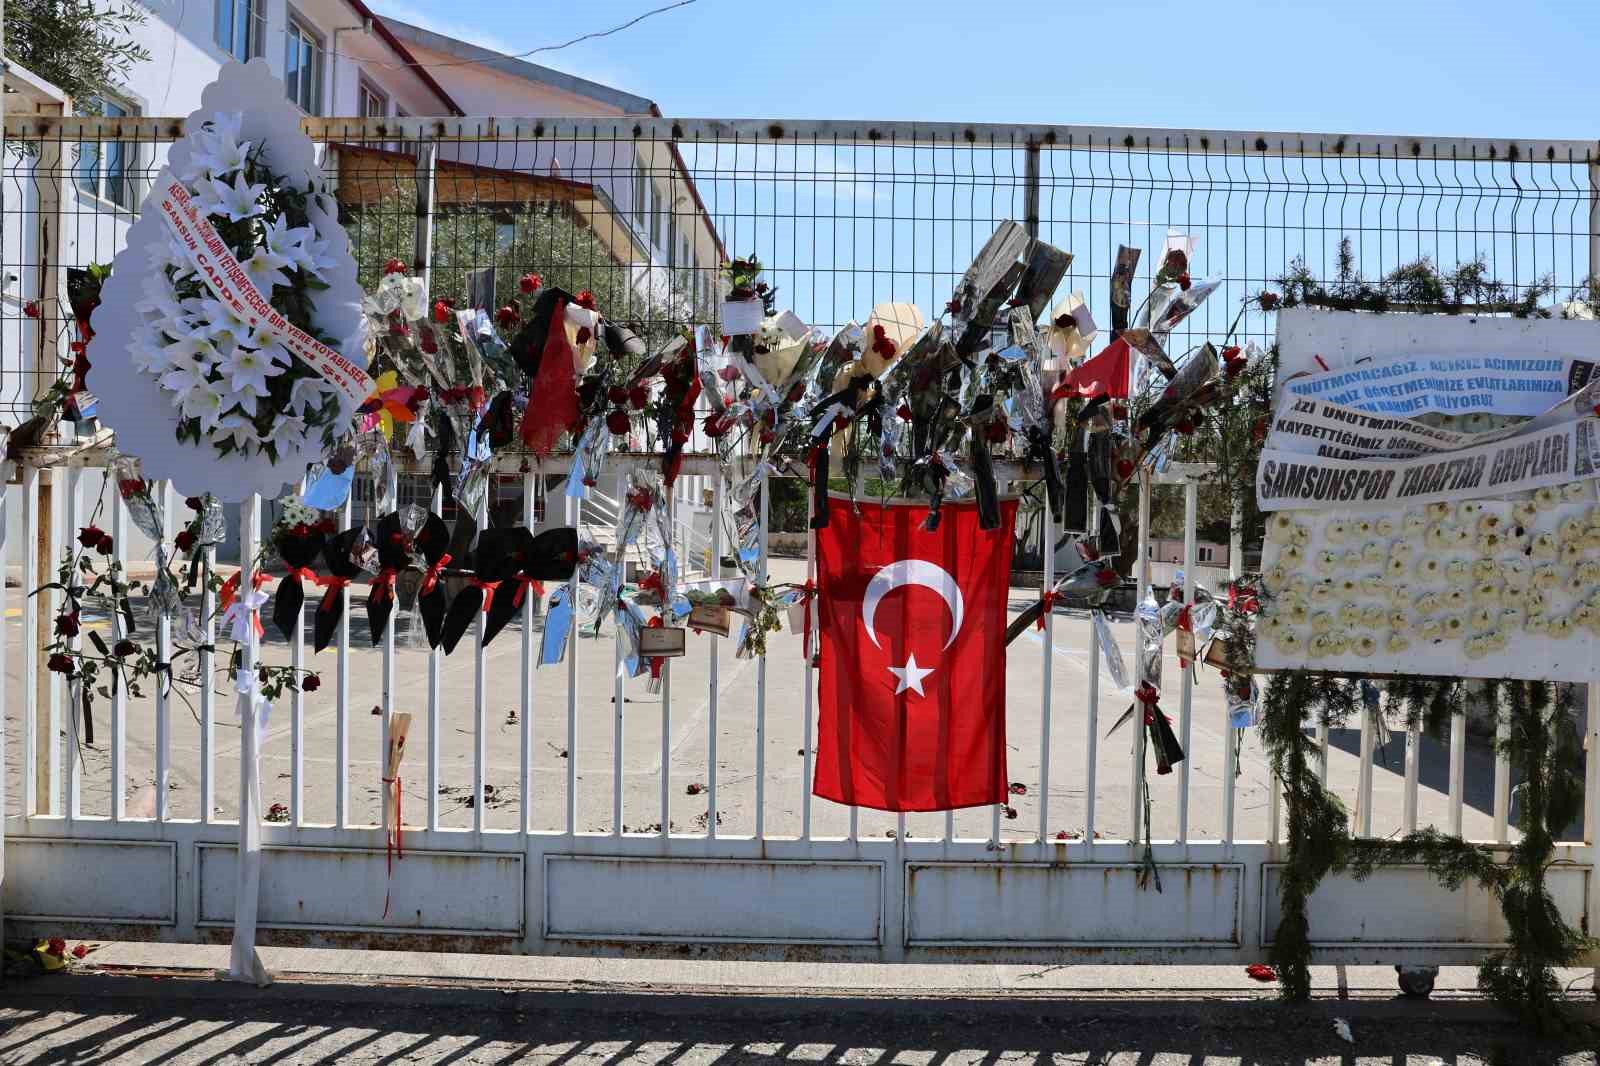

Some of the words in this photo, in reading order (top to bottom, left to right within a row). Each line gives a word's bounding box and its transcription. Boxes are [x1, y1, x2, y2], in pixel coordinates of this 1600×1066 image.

[161, 199, 198, 252] SAMSUN
[287, 325, 313, 346] YERE
[1276, 418, 1385, 450] KAYBETTİĞİMİZ
[1260, 459, 1396, 501] SAMSUNSPOR
[1396, 454, 1487, 497] TARAFTAR
[1488, 431, 1570, 488] GRUPLARI
